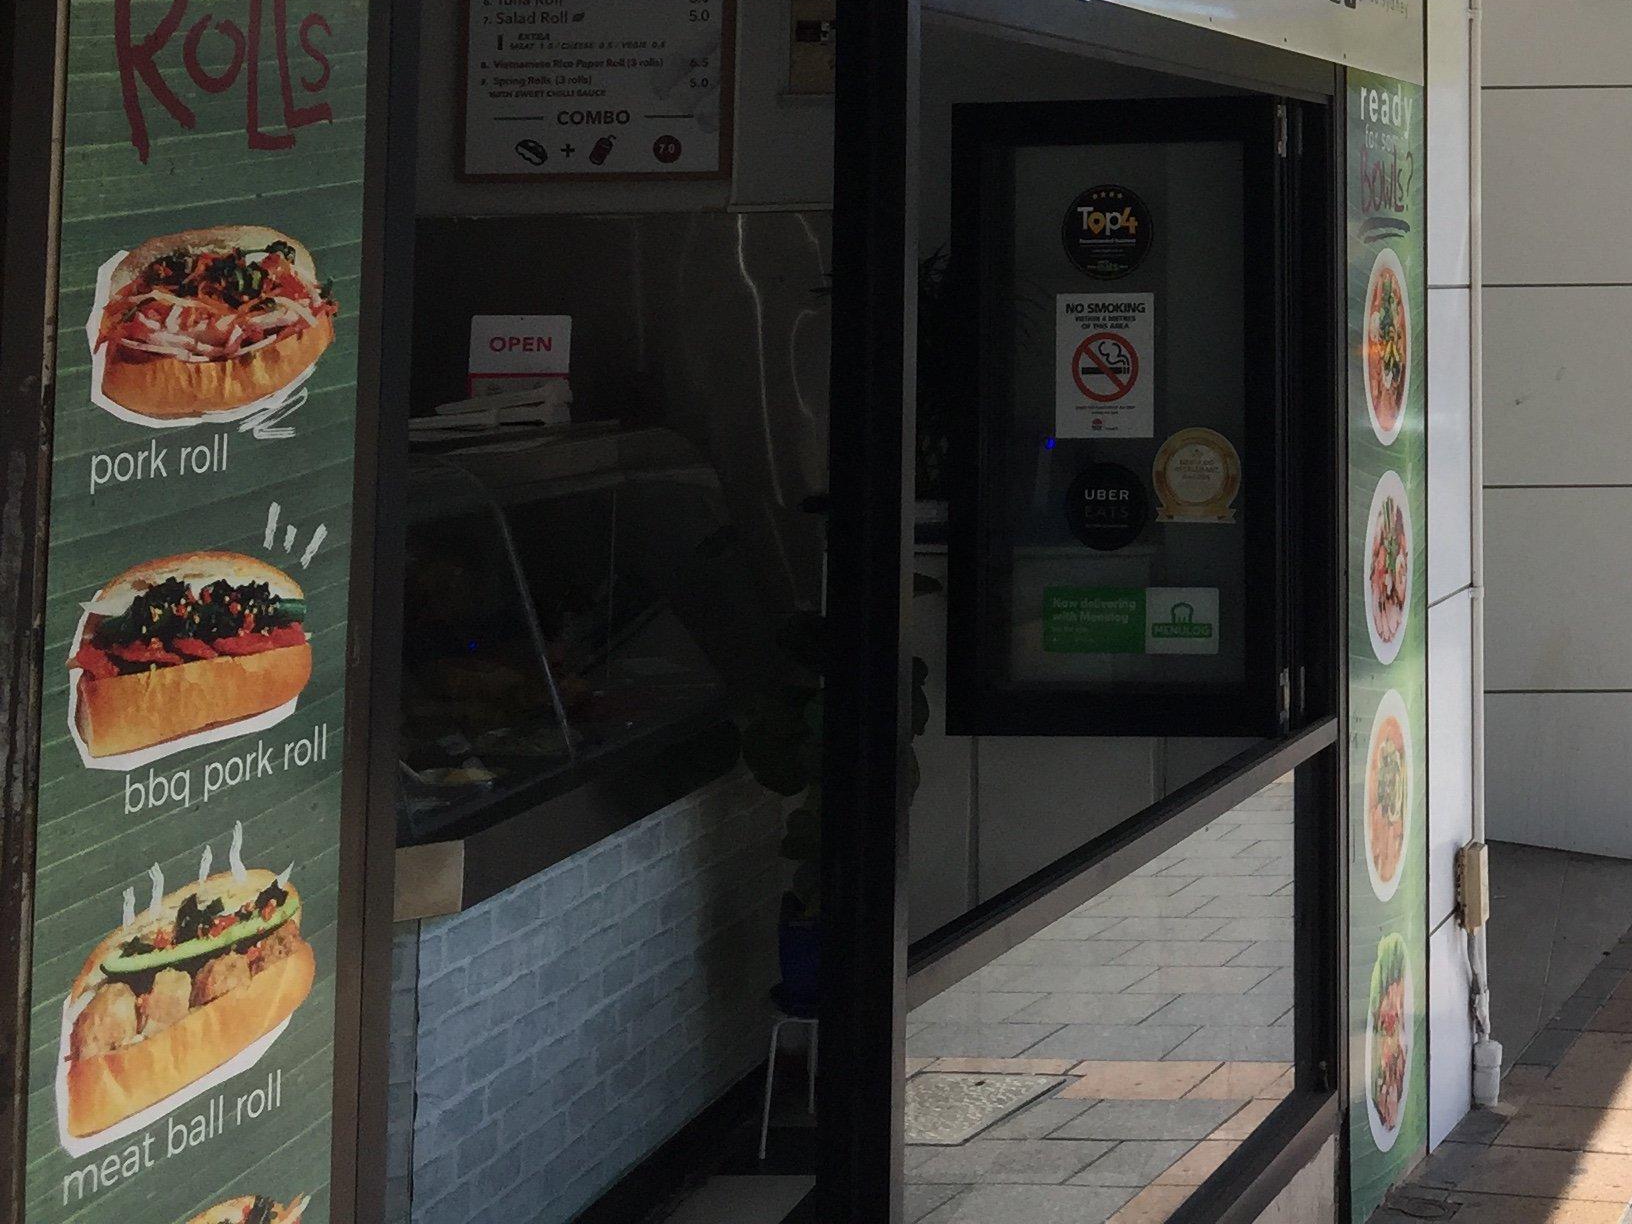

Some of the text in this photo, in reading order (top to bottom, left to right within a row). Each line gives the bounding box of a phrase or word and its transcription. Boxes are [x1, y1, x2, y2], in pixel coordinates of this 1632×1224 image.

[496, 10, 536, 25] Salad
[540, 9, 569, 24] Roll
[689, 9, 711, 23] 5.0
[557, 110, 631, 126] COMBO
[1360, 82, 1414, 141] ready
[1076, 206, 1139, 237] Top4
[1065, 302, 1146, 314] NO SMOKING
[488, 335, 553, 353] OPEN
[90, 433, 228, 494] pork roll
[1083, 489, 1130, 501] UBER
[1053, 597, 1137, 610] Now delivering
[123, 722, 327, 815] bbq pork roll
[62, 1070, 282, 1206] meat ball roll
